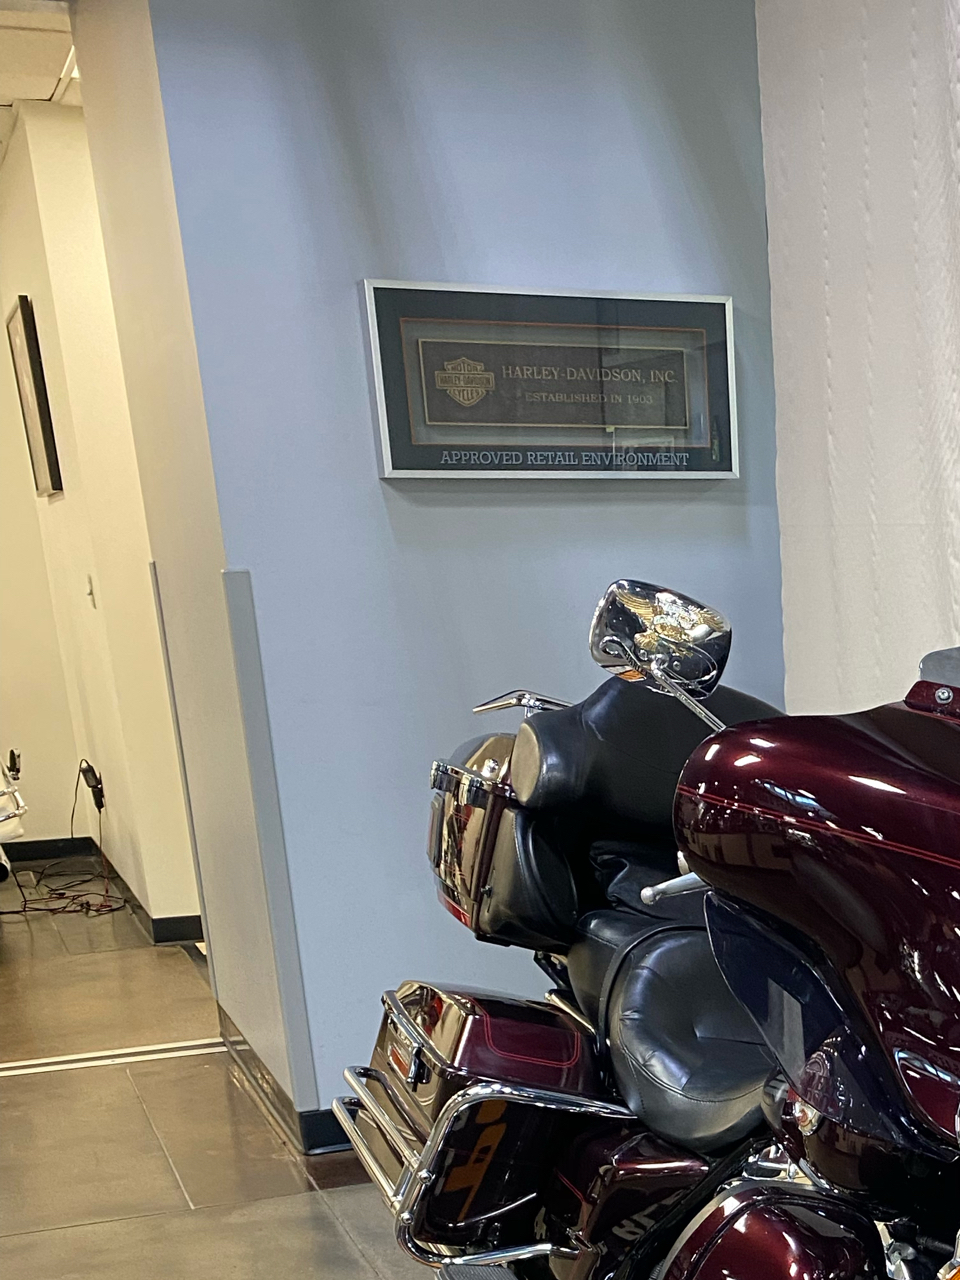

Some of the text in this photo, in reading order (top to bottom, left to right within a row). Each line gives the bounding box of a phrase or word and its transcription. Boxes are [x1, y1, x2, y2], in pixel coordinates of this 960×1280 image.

[502, 366, 646, 384] HARLEY-DAVIDSON,
[525, 392, 654, 405] ESTABLISHED IN 1903
[440, 451, 690, 466] APPROVED RETAIL ENVIRONMENT
